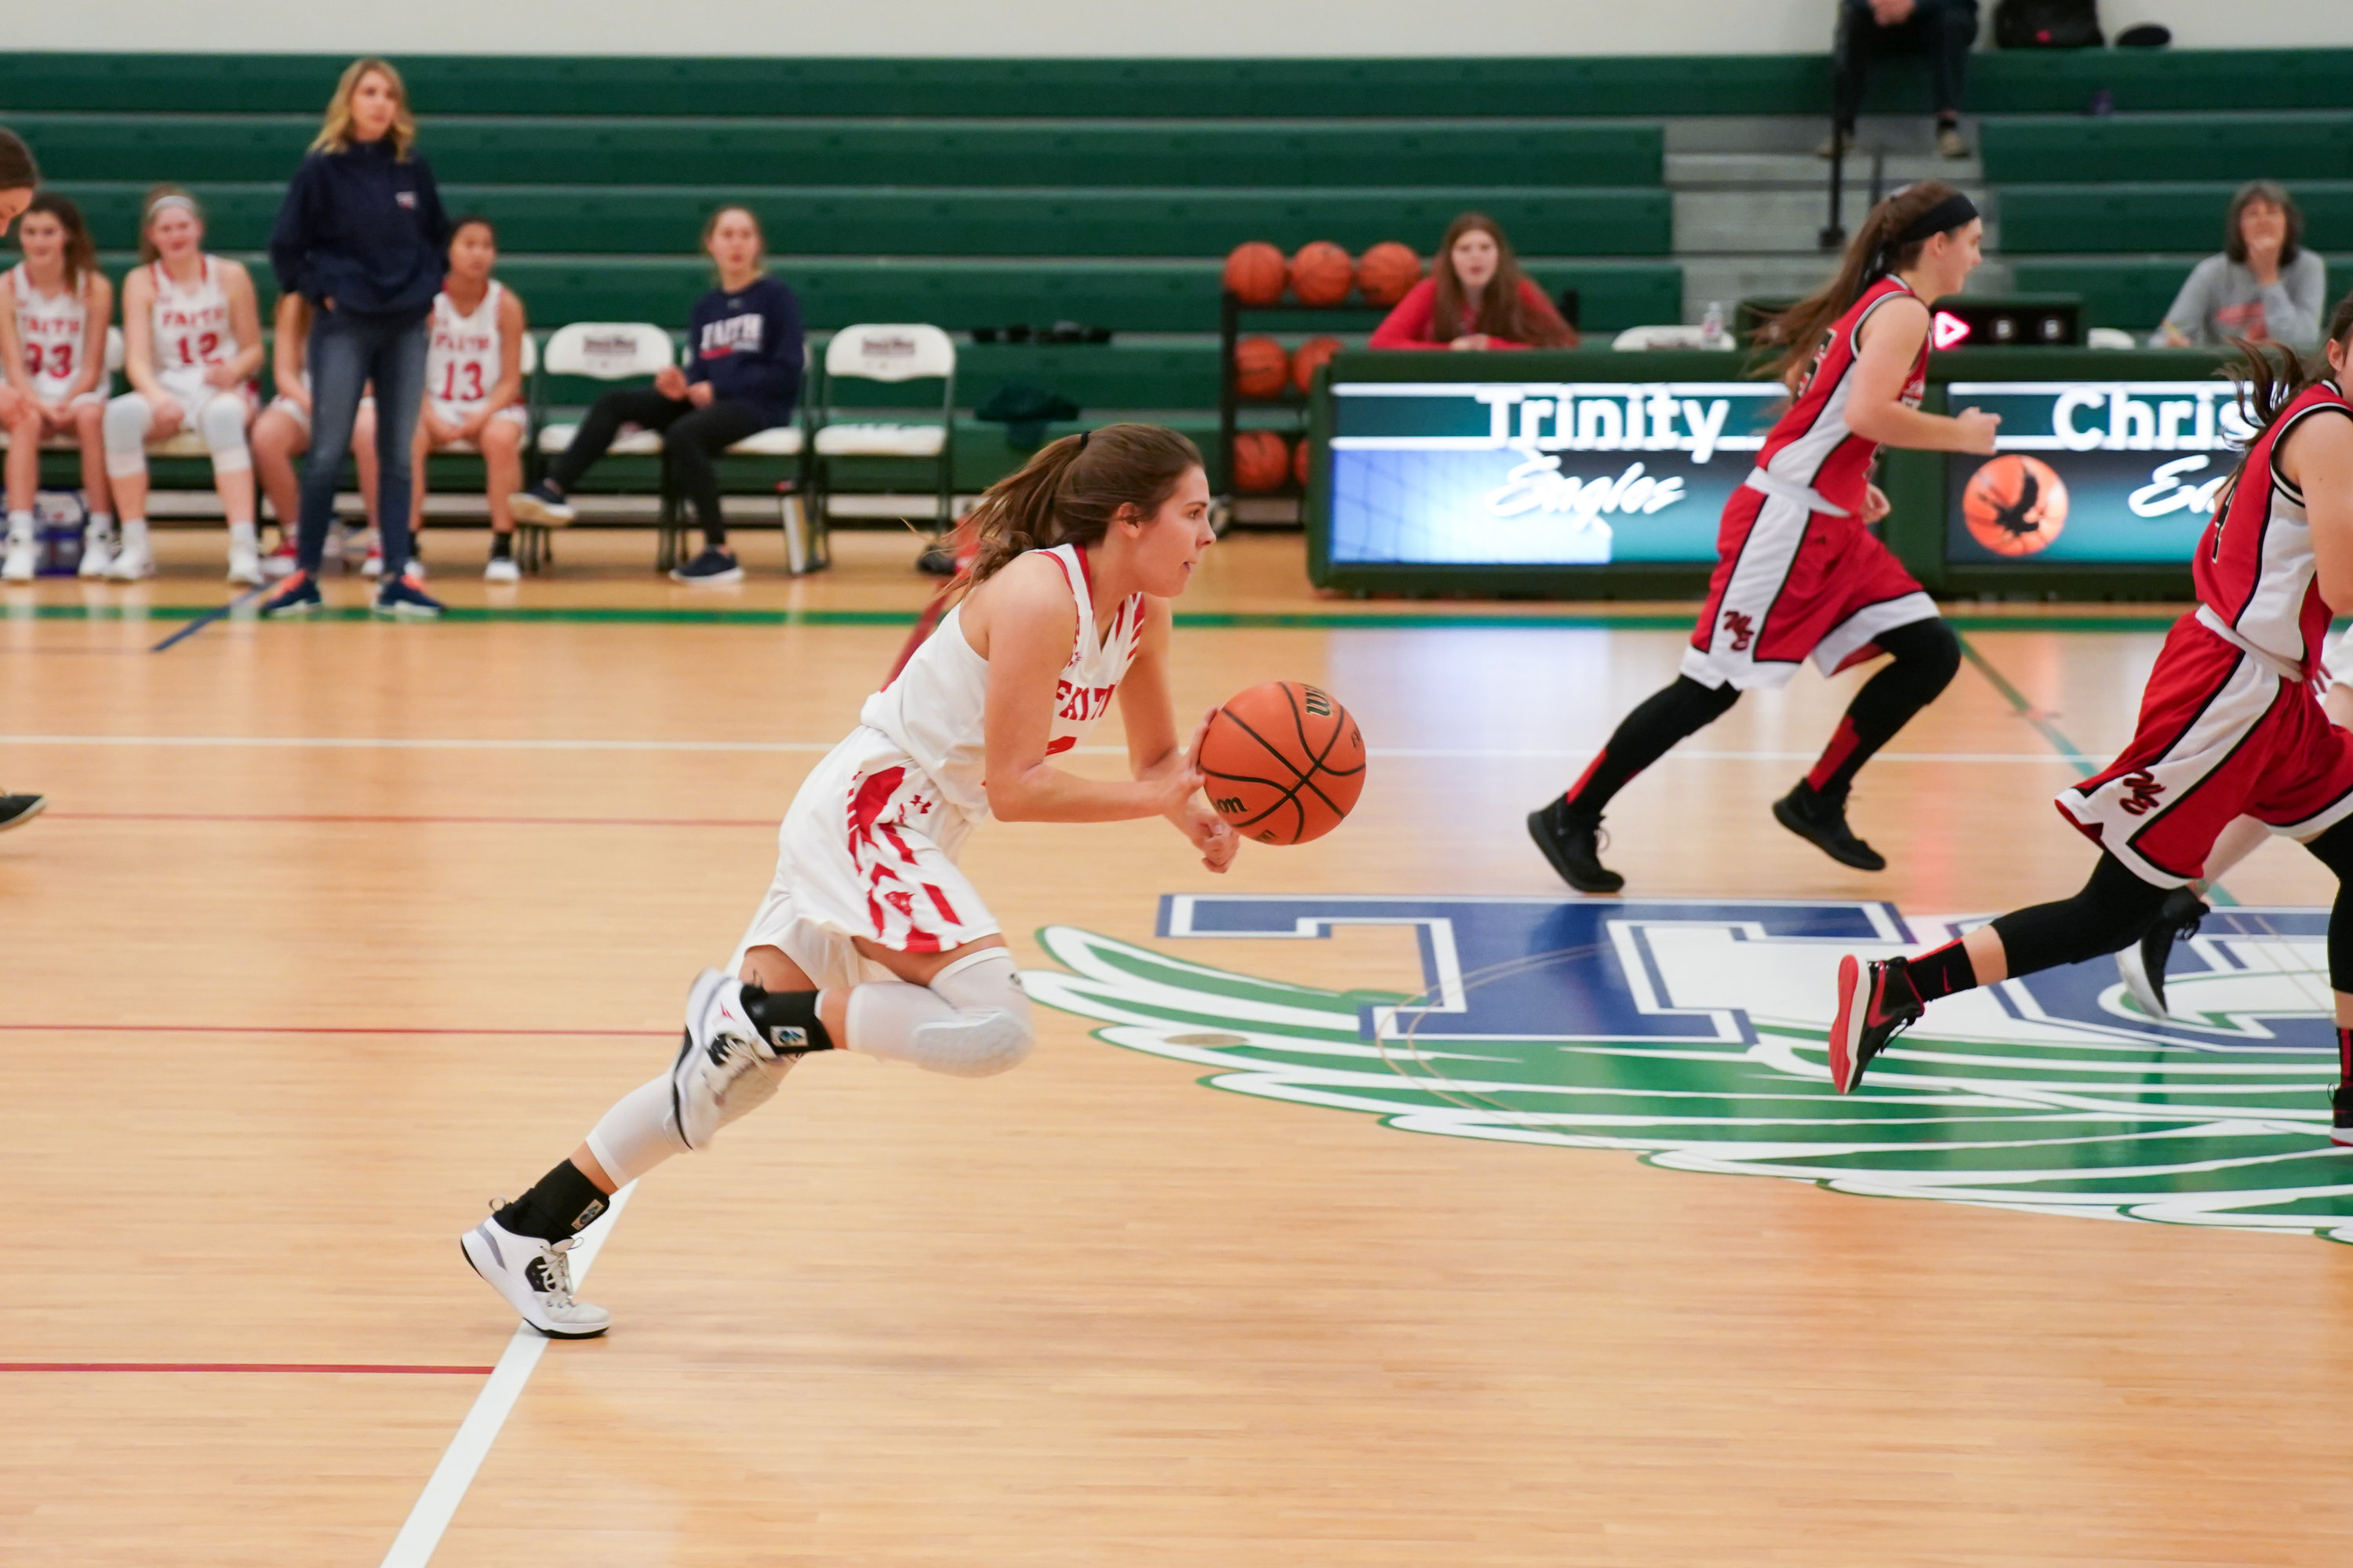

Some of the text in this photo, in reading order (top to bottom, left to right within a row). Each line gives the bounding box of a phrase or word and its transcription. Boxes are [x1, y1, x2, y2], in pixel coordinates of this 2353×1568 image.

[162, 308, 226, 327] FAITH
[700, 313, 762, 351] FAITH
[177, 331, 224, 365] 12
[435, 334, 490, 350] FAITH
[440, 361, 485, 401] 13
[1475, 384, 1730, 464] Trinity
[2052, 384, 2264, 453] Chris
[1486, 455, 1686, 532] Eagles
[1055, 678, 1118, 722] FAIT
